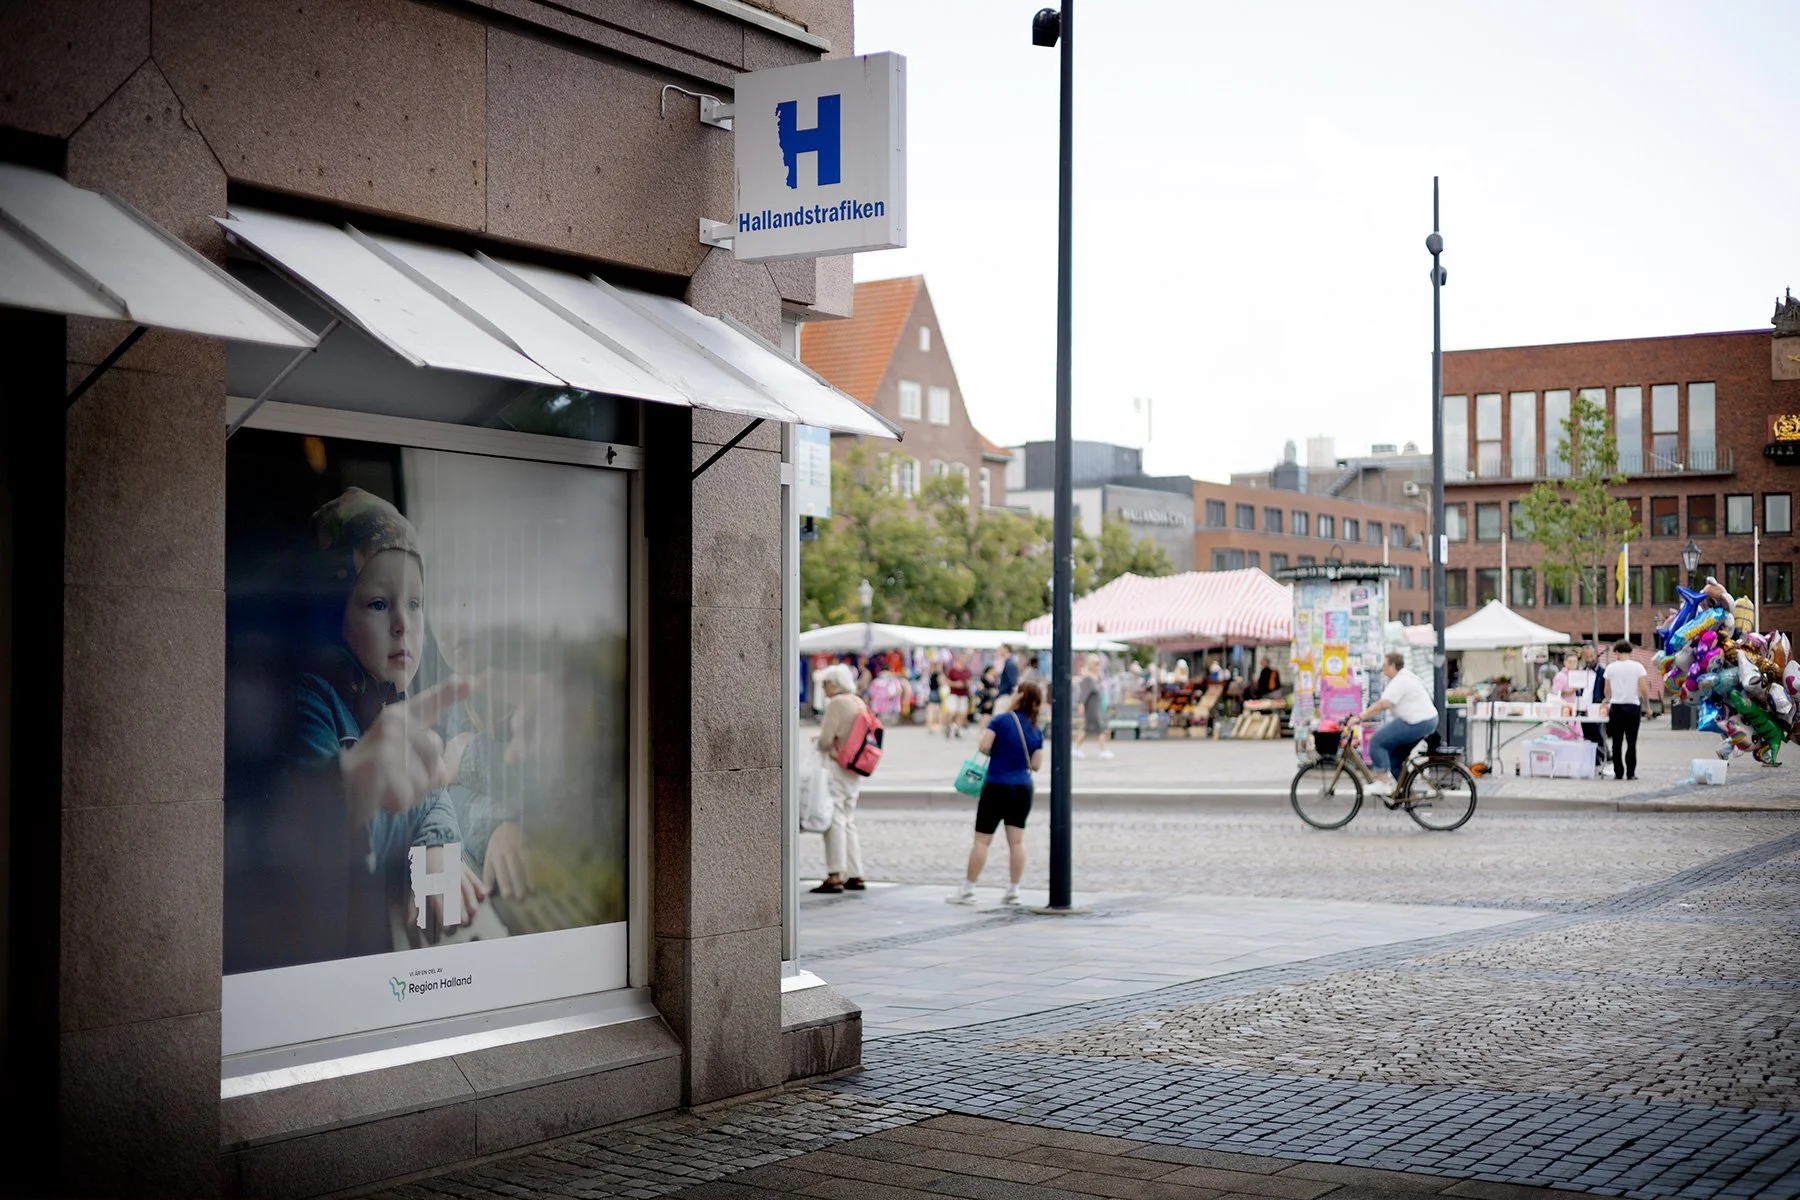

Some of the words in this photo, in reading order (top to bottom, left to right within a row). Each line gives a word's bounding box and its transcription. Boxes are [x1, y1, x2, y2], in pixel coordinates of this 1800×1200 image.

[775, 94, 841, 189] H
[738, 199, 885, 233] Hallandstrafiken
[408, 842, 461, 929] H
[408, 981, 438, 995] Region
[440, 974, 472, 989] Halland
